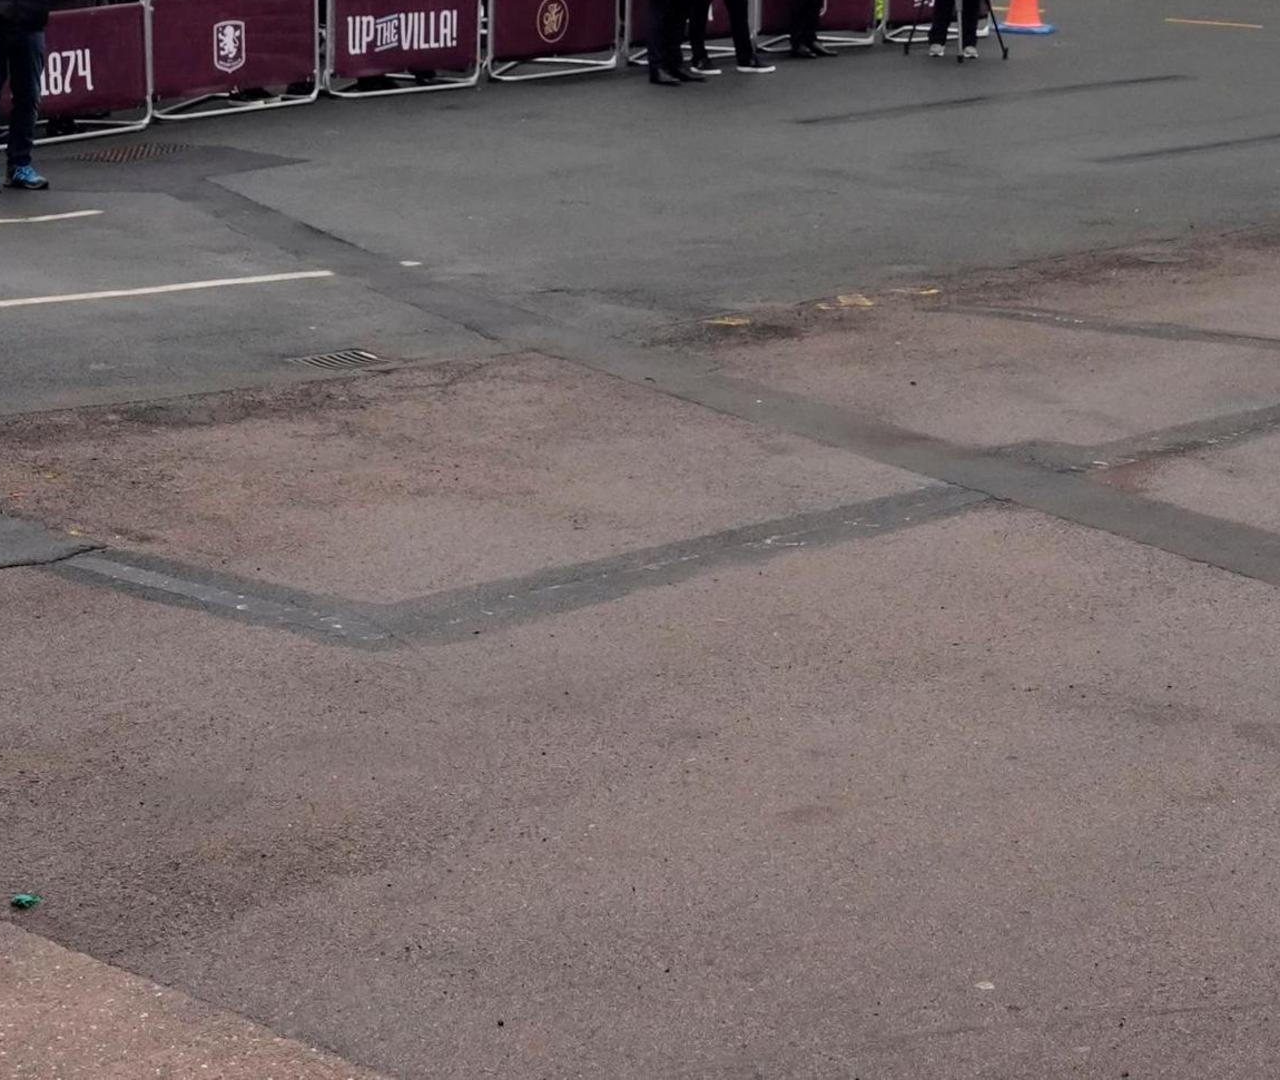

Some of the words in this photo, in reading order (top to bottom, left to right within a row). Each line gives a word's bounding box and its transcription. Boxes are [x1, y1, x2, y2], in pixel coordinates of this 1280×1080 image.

[347, 15, 375, 55] UP
[375, 19, 399, 46] THE
[400, 9, 458, 51] VILLA!
